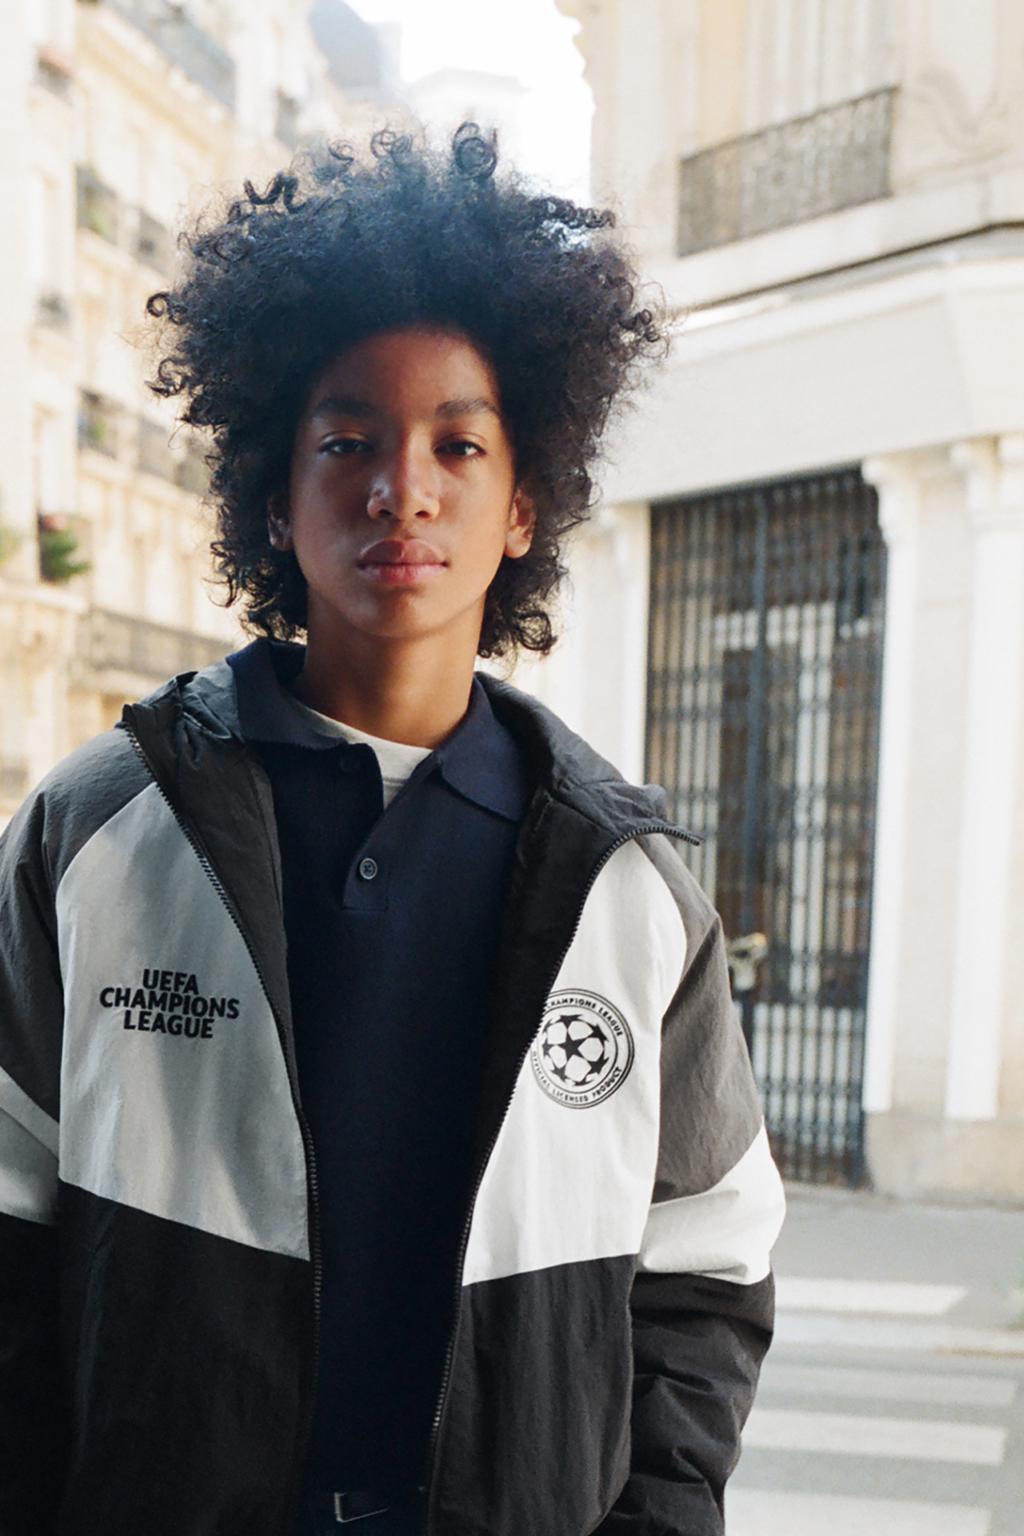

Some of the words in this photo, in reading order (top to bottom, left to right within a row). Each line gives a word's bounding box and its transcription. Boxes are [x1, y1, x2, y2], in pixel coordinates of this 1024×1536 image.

[142, 968, 199, 995] UEFA
[99, 987, 240, 1020] CHAMPIONS
[123, 1010, 215, 1039] LEAGUE
[598, 1007, 624, 1037] LEAGUE
